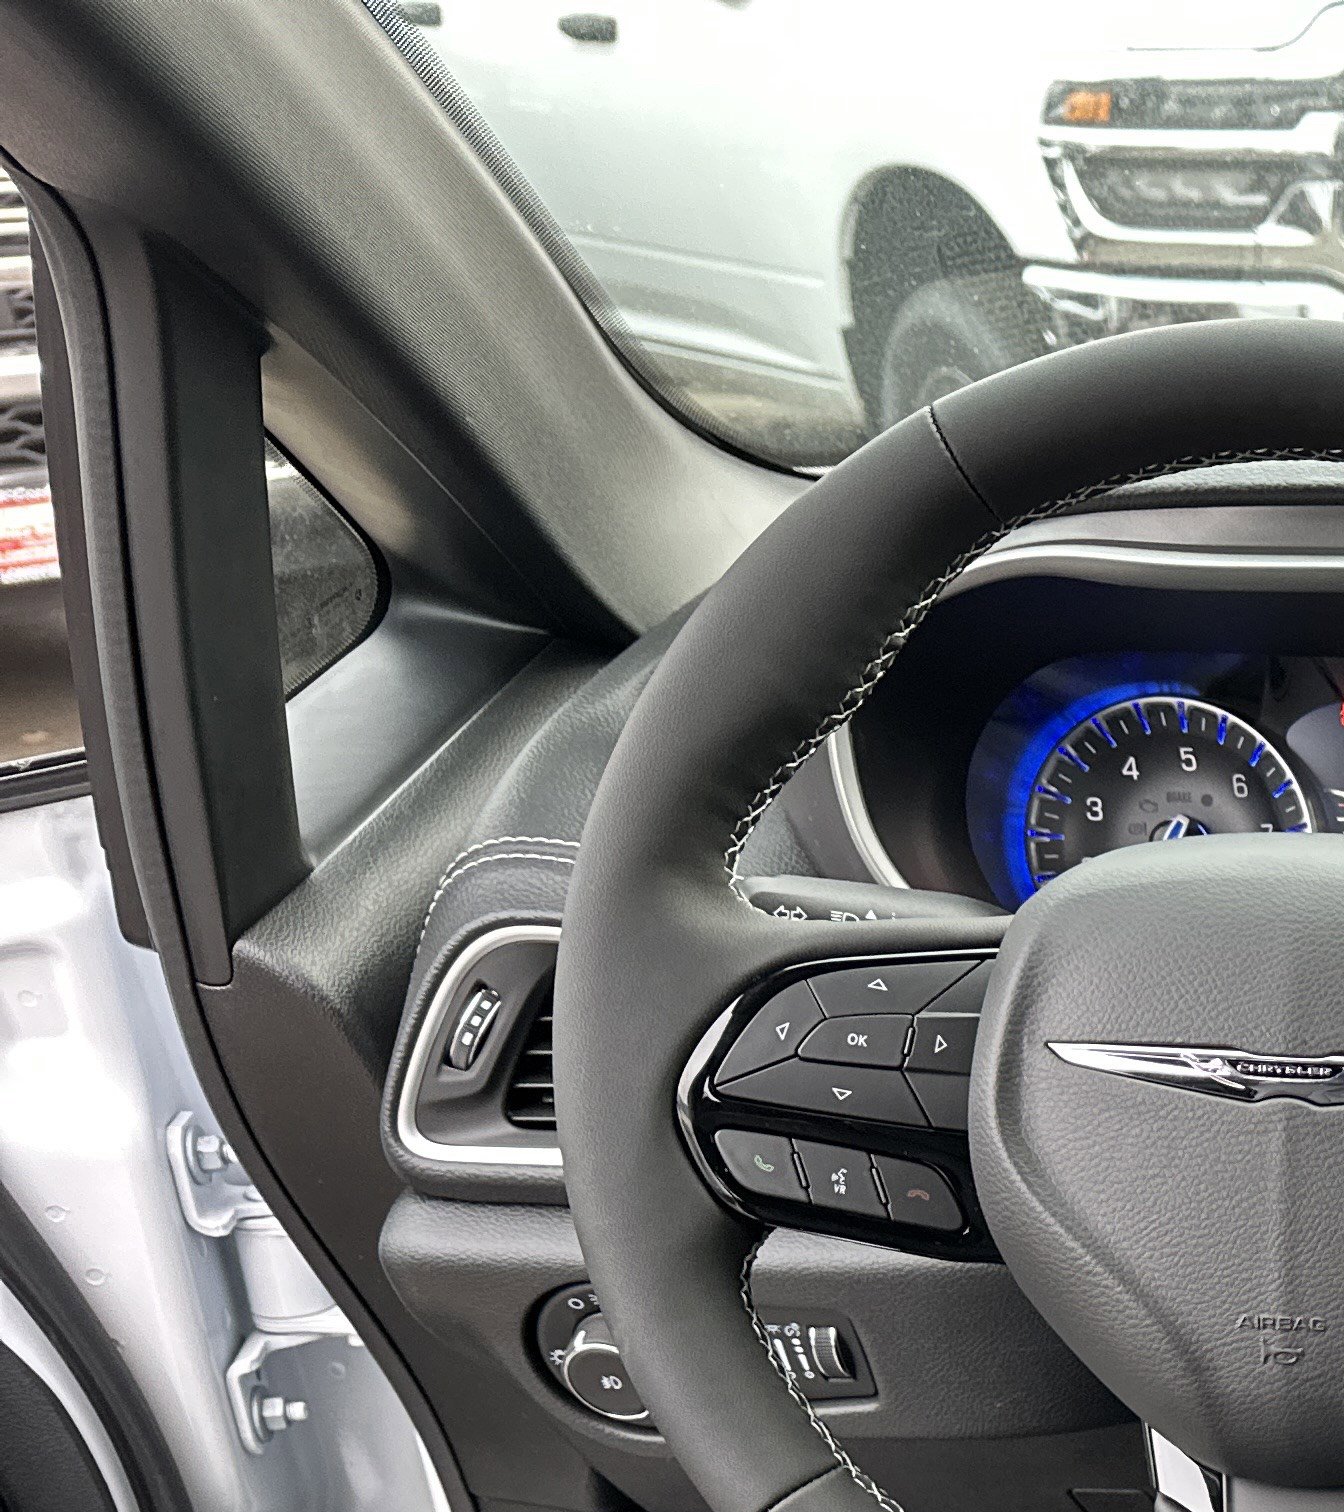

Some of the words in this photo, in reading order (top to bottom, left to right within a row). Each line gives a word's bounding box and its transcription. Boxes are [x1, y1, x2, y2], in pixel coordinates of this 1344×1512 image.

[1121, 756, 1140, 781] 4
[1179, 747, 1197, 772] 5
[1232, 773, 1248, 798] 6
[1086, 797, 1104, 821] 3
[847, 1033, 868, 1047] OK
[1236, 1061, 1332, 1077] CHRYSLER
[833, 1183, 847, 1195] VR
[1234, 1314, 1326, 1332] AIRBAG
